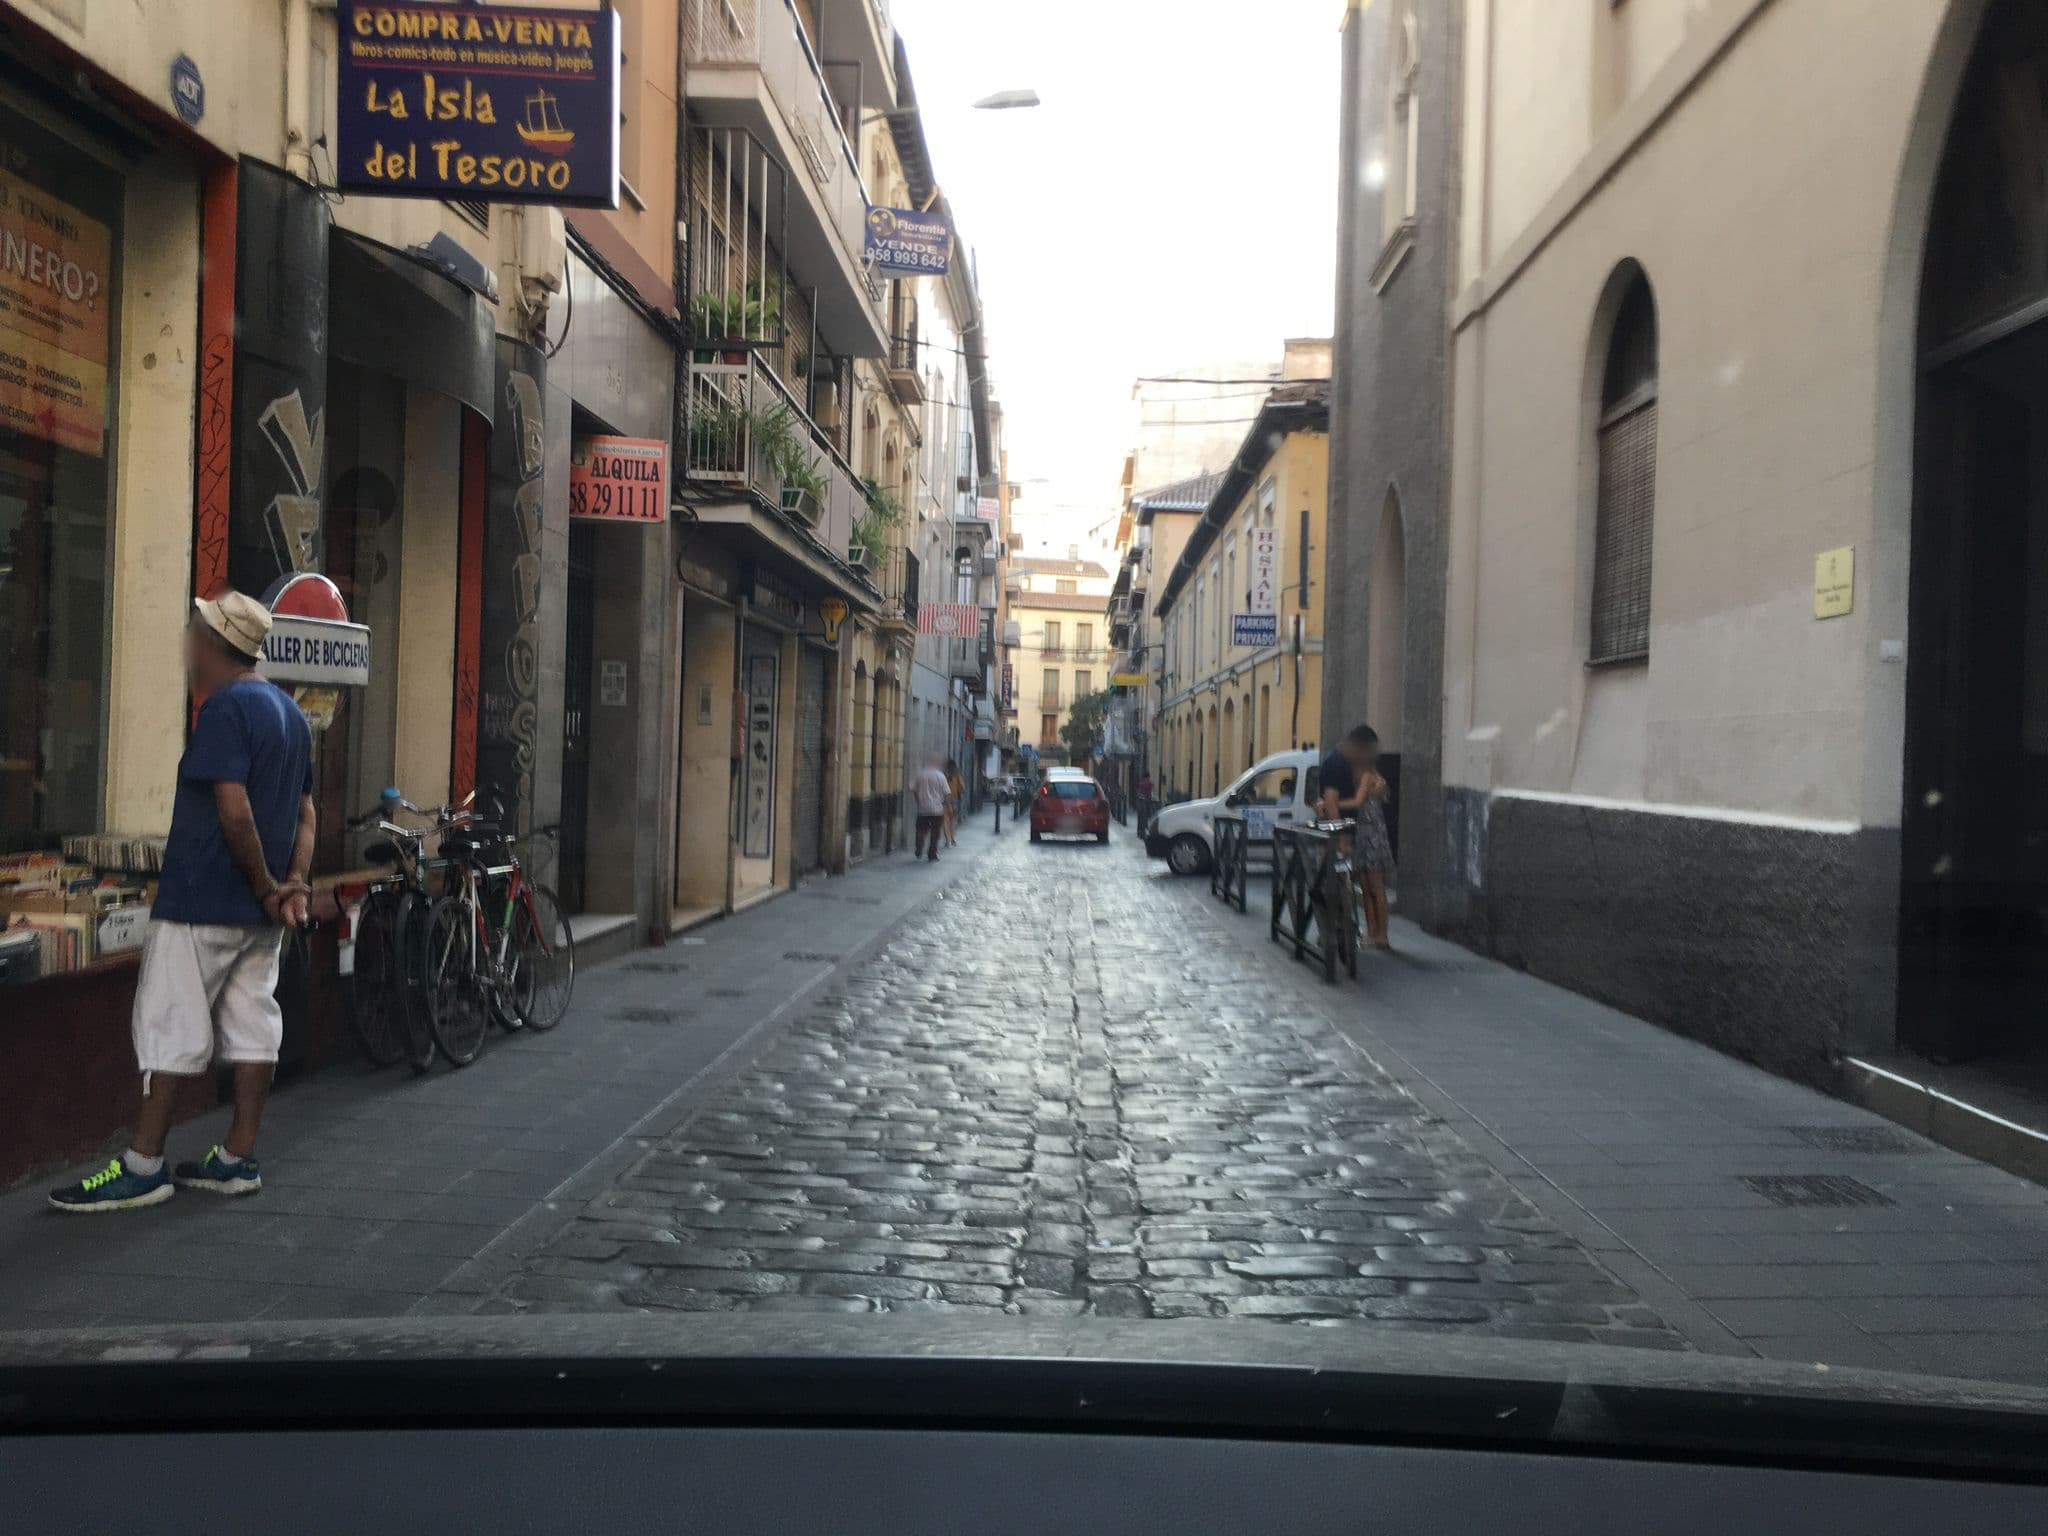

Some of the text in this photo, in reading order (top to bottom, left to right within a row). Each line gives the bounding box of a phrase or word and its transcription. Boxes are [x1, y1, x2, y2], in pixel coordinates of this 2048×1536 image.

[460, 47, 475, 63] en
[555, 53, 594, 73] juegos
[178, 75, 200, 104] ADT
[366, 71, 497, 124] La Isla
[365, 137, 571, 191] del Tesoro
[866, 247, 891, 262] 958
[894, 250, 919, 265] 993
[921, 254, 945, 268] 642
[874, 238, 938, 255] VENDE
[0, 229, 98, 312] NERO?
[590, 457, 661, 482] ALQUILA
[591, 483, 612, 515] 29
[616, 485, 634, 516] 11
[640, 486, 659, 518] 11
[1257, 531, 1273, 602] HOSTAL
[1236, 616, 1275, 631] PARKING
[261, 635, 368, 669] ALLER DE BICICLETAS
[1235, 632, 1275, 647] PRIVADO
